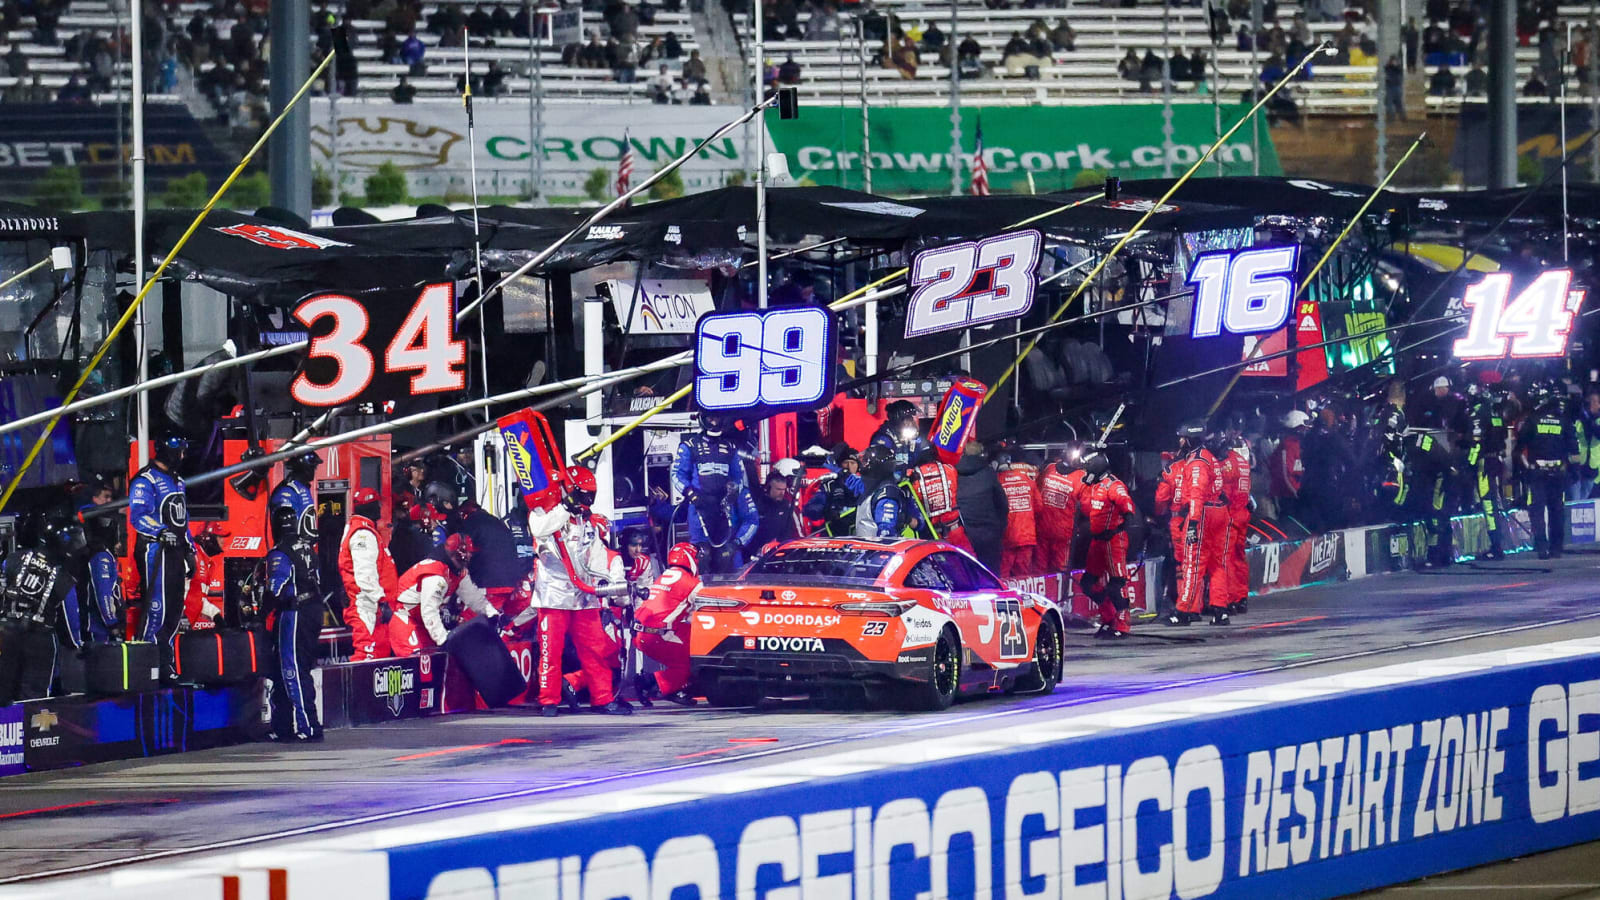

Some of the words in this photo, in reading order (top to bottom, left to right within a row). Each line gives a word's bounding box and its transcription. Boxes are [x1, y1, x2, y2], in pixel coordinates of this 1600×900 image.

[485, 136, 739, 161] CROWN
[797, 143, 1254, 172] CrownCork.com
[904, 229, 1042, 339] 23
[1189, 246, 1296, 339] 16
[1301, 304, 1315, 314] 24
[1453, 269, 1573, 360] 14
[291, 282, 466, 407] 34
[696, 307, 829, 410] 99
[941, 395, 963, 446] SUNOCO
[506, 432, 532, 489] SUNOCO
[757, 636, 825, 652] TOYOTA
[764, 613, 841, 627] DOORDASH
[862, 621, 888, 636] 23
[914, 618, 932, 629] leidos
[994, 598, 1028, 660] 23
[541, 634, 549, 689] DOORDASH
[30, 736, 60, 748] CHEVROLET
[1239, 723, 1414, 877] RESTART
[1413, 706, 1510, 837] ZONE
[737, 786, 991, 900] GEICO
[1004, 744, 1225, 900] GEICO
